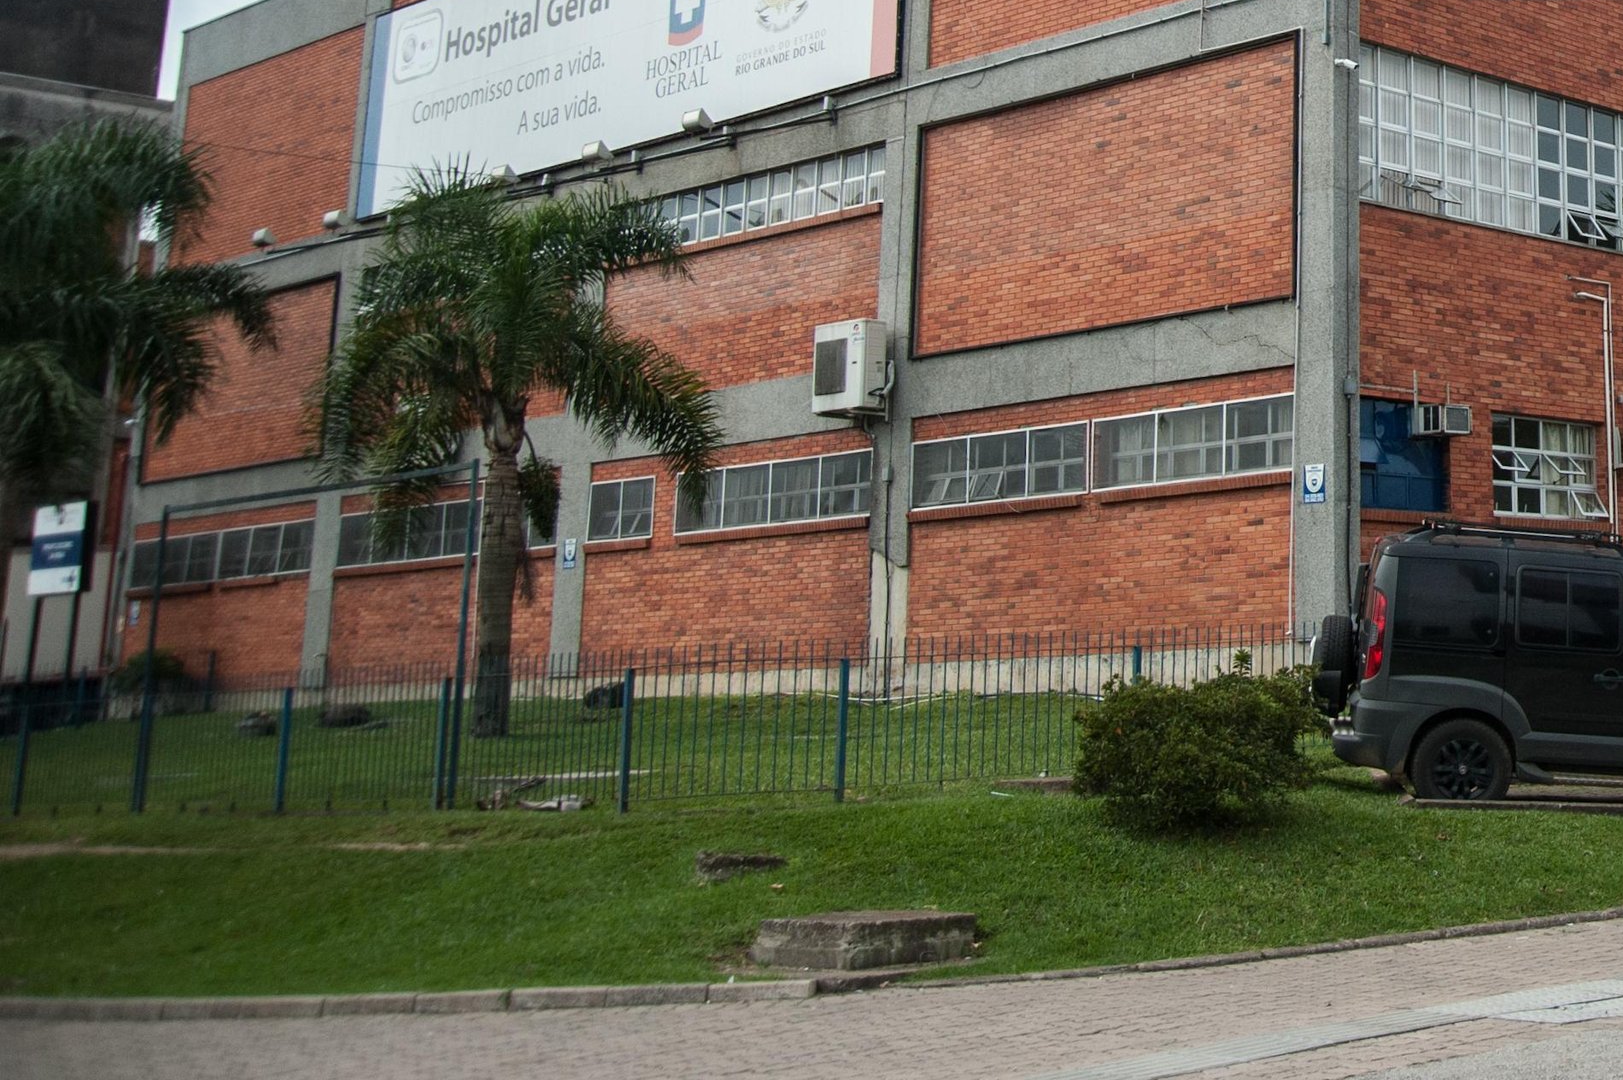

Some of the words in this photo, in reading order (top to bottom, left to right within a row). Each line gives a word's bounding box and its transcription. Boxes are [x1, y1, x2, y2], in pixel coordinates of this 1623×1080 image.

[646, 40, 723, 80] HOSPITAL
[735, 62, 751, 76] RIO
[753, 50, 790, 71] GRANDE
[792, 45, 806, 59] DO
[808, 39, 827, 54] SUL
[736, 43, 775, 63] GOVERNO
[778, 39, 791, 51] DO
[794, 28, 827, 46] ESTADO
[413, 79, 513, 124] Compromisso
[517, 66, 549, 93] com
[554, 62, 563, 81] a
[568, 46, 605, 77] vida.
[655, 66, 709, 98] GERAL
[517, 110, 529, 135] A
[533, 107, 559, 131] sua
[564, 90, 601, 121] vida.
